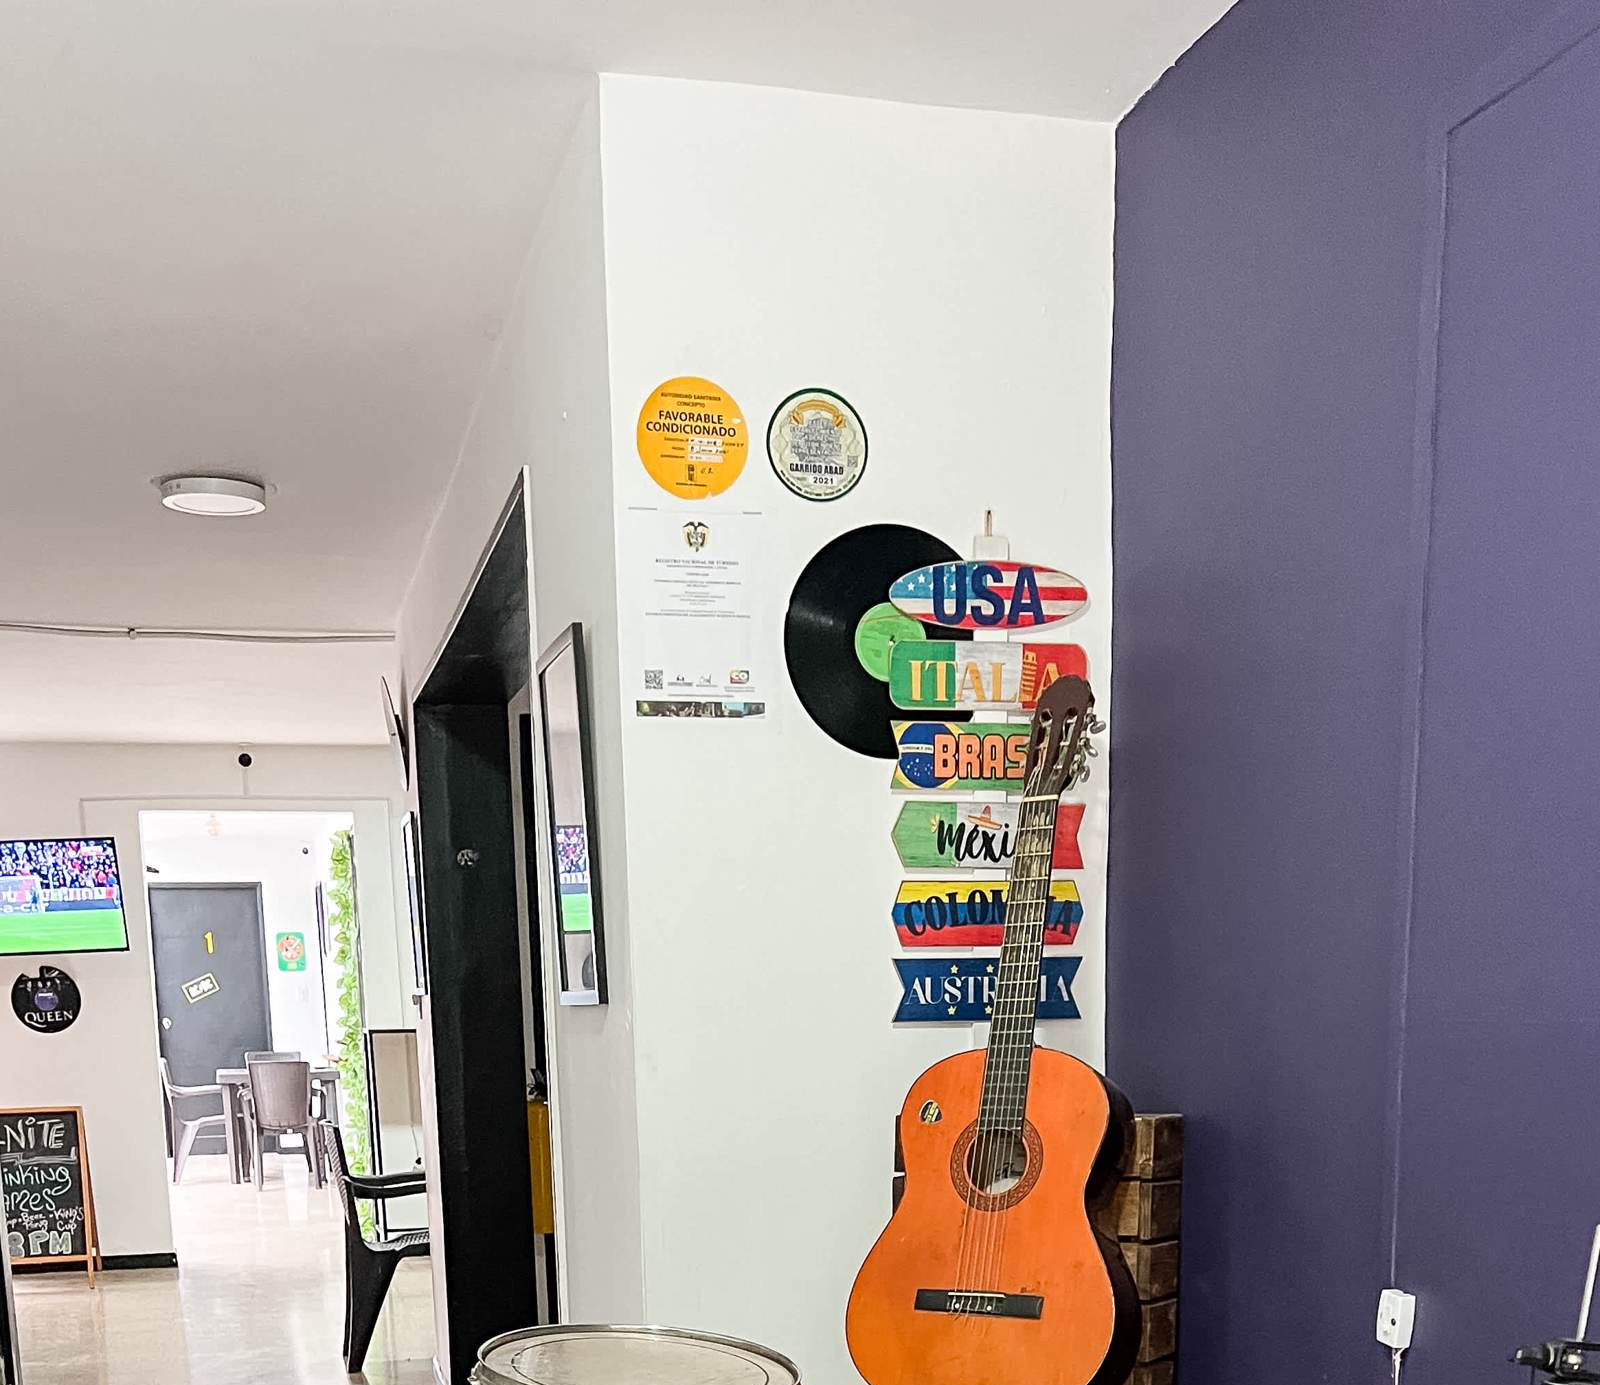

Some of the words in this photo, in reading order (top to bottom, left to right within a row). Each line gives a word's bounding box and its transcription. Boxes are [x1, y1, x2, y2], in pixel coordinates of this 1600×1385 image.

[646, 421, 737, 438] CONDICIONADO
[658, 410, 724, 425] FAVORABLE
[813, 476, 834, 485] 2021
[931, 565, 1046, 626] USA
[934, 733, 1029, 779] BRAS
[936, 820, 1014, 864] méxi
[204, 931, 215, 955] 1
[905, 973, 1071, 1005] AUSTRIA
[24, 1010, 73, 1028] QUEEN
[28, 1230, 72, 1256] PM
